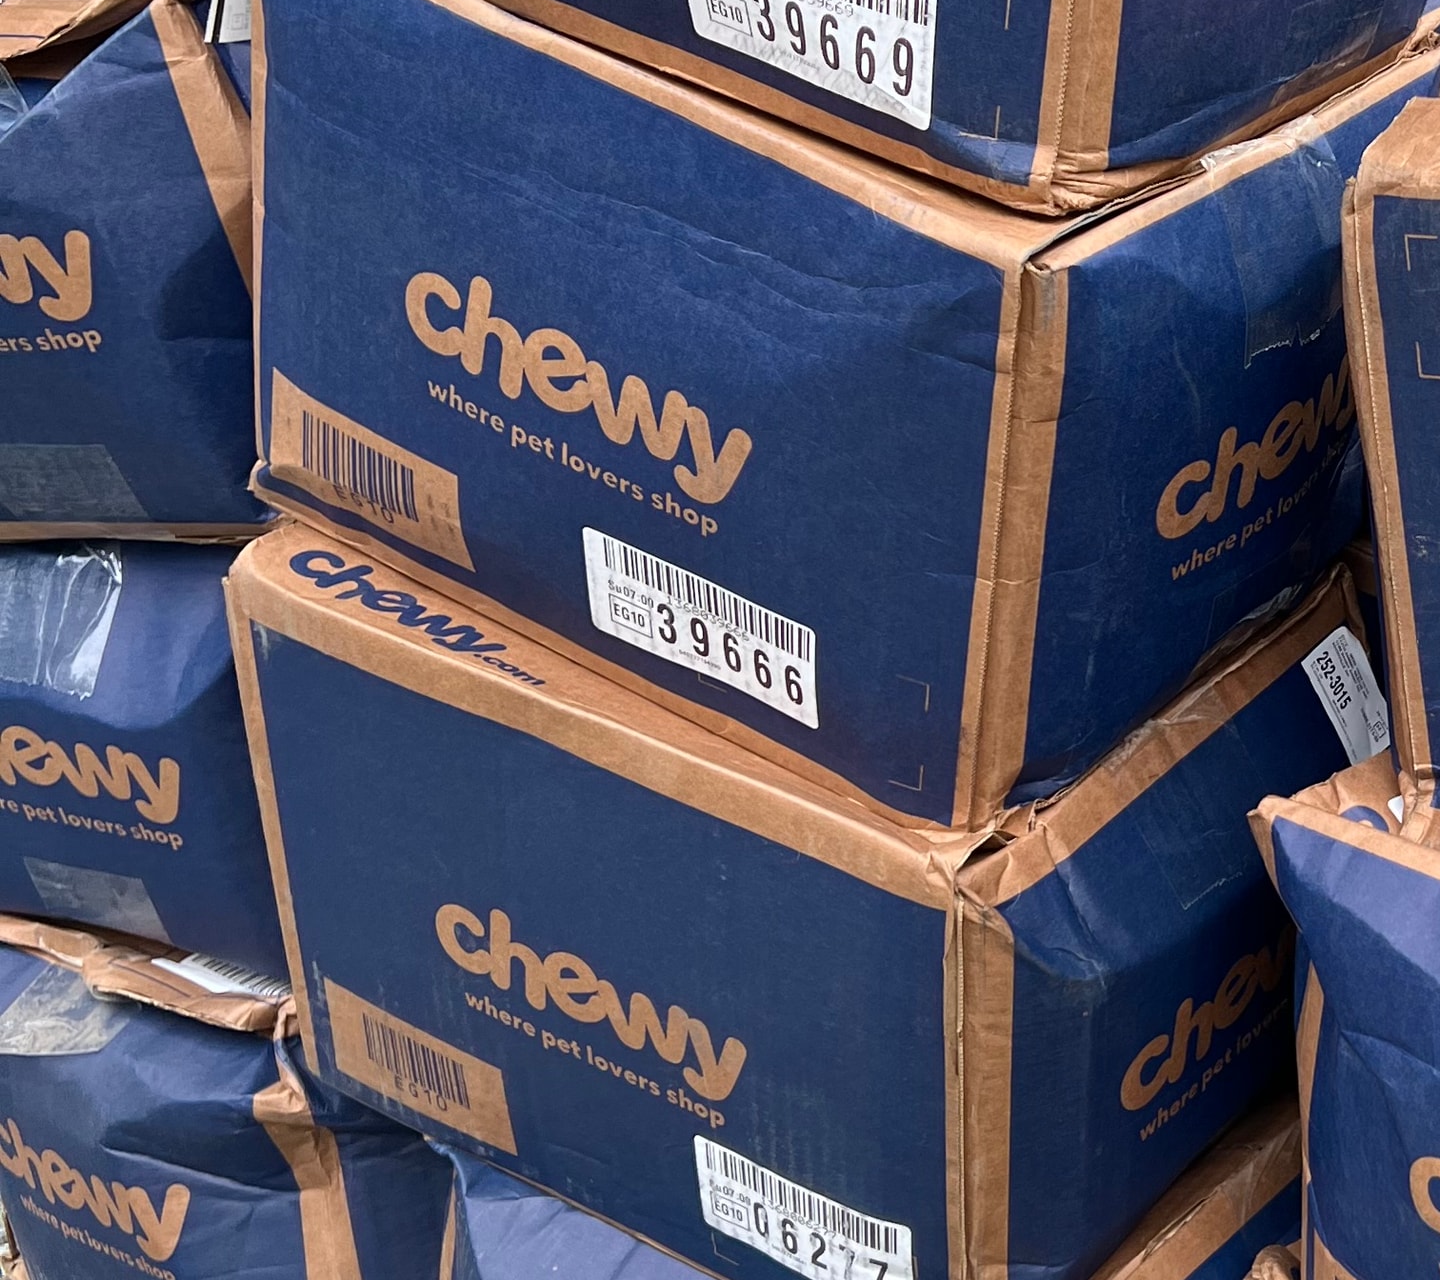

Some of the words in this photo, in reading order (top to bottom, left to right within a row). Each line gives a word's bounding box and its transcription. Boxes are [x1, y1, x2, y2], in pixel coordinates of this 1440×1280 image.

[36, 328, 102, 353] shop
[405, 271, 753, 504] chewy
[428, 378, 506, 433] where
[510, 424, 555, 461] pet
[561, 441, 644, 502] lovers
[651, 490, 719, 537] shop
[1171, 534, 1236, 581] where
[1240, 505, 1274, 541] pet
[613, 603, 646, 628] EG10
[657, 603, 804, 705] 39666
[1316, 651, 1352, 710] 252-3015
[23, 802, 59, 823] pet
[60, 807, 127, 837] lovers
[129, 824, 183, 851] shop
[434, 903, 747, 1102] chewy
[393, 1073, 449, 1113] EG10
[465, 989, 537, 1038] where
[541, 1027, 583, 1061] pet
[586, 1043, 660, 1097] lovers
[666, 1087, 726, 1129] shop
[1139, 1081, 1199, 1142] where
[1201, 1050, 1233, 1093] pet
[19, 1194, 60, 1231] where
[61, 1219, 87, 1245] pet
[87, 1237, 134, 1266] lovers
[714, 1201, 743, 1221] EG10
